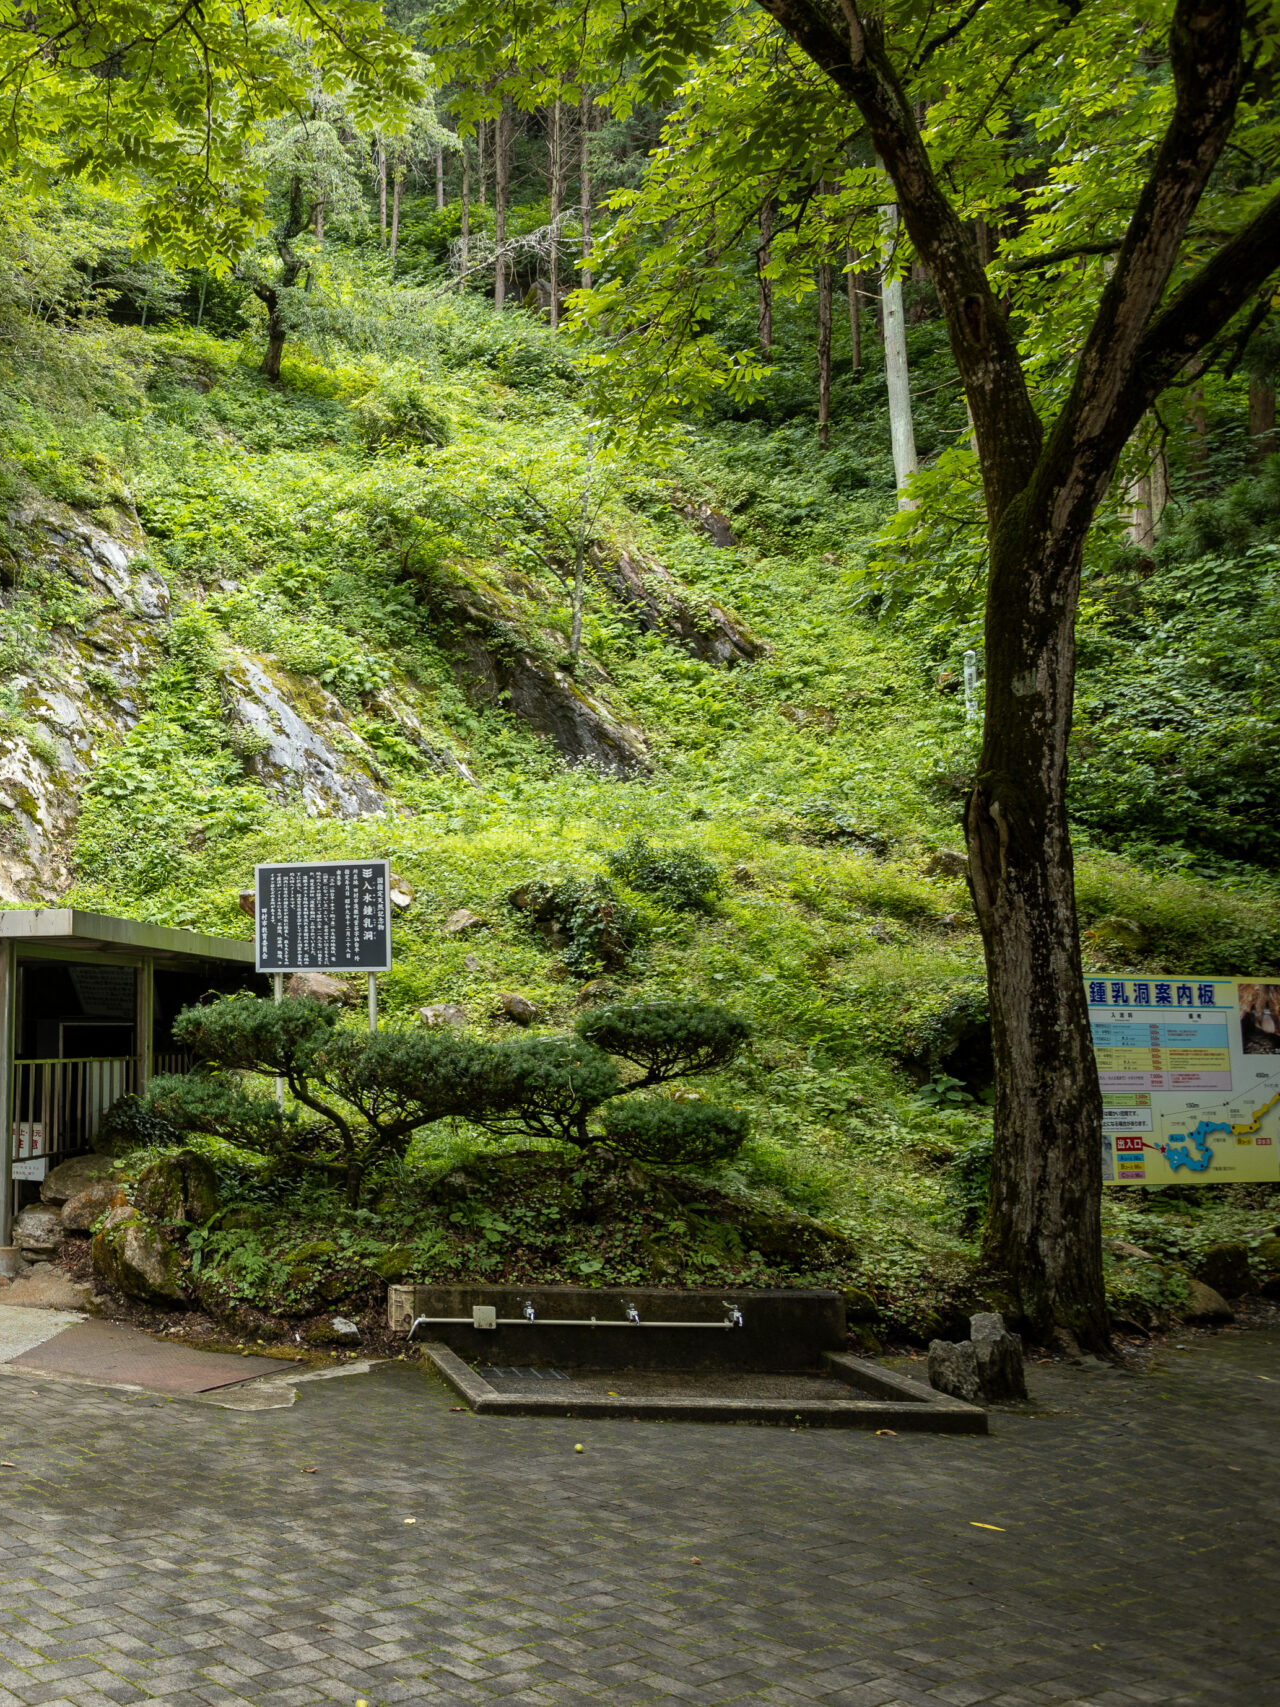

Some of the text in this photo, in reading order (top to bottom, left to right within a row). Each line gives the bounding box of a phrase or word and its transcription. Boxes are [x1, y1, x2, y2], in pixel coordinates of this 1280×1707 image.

[1089, 981, 1216, 1006] 鍾乳洞案内板
[1117, 1138, 1142, 1149] 出入口
